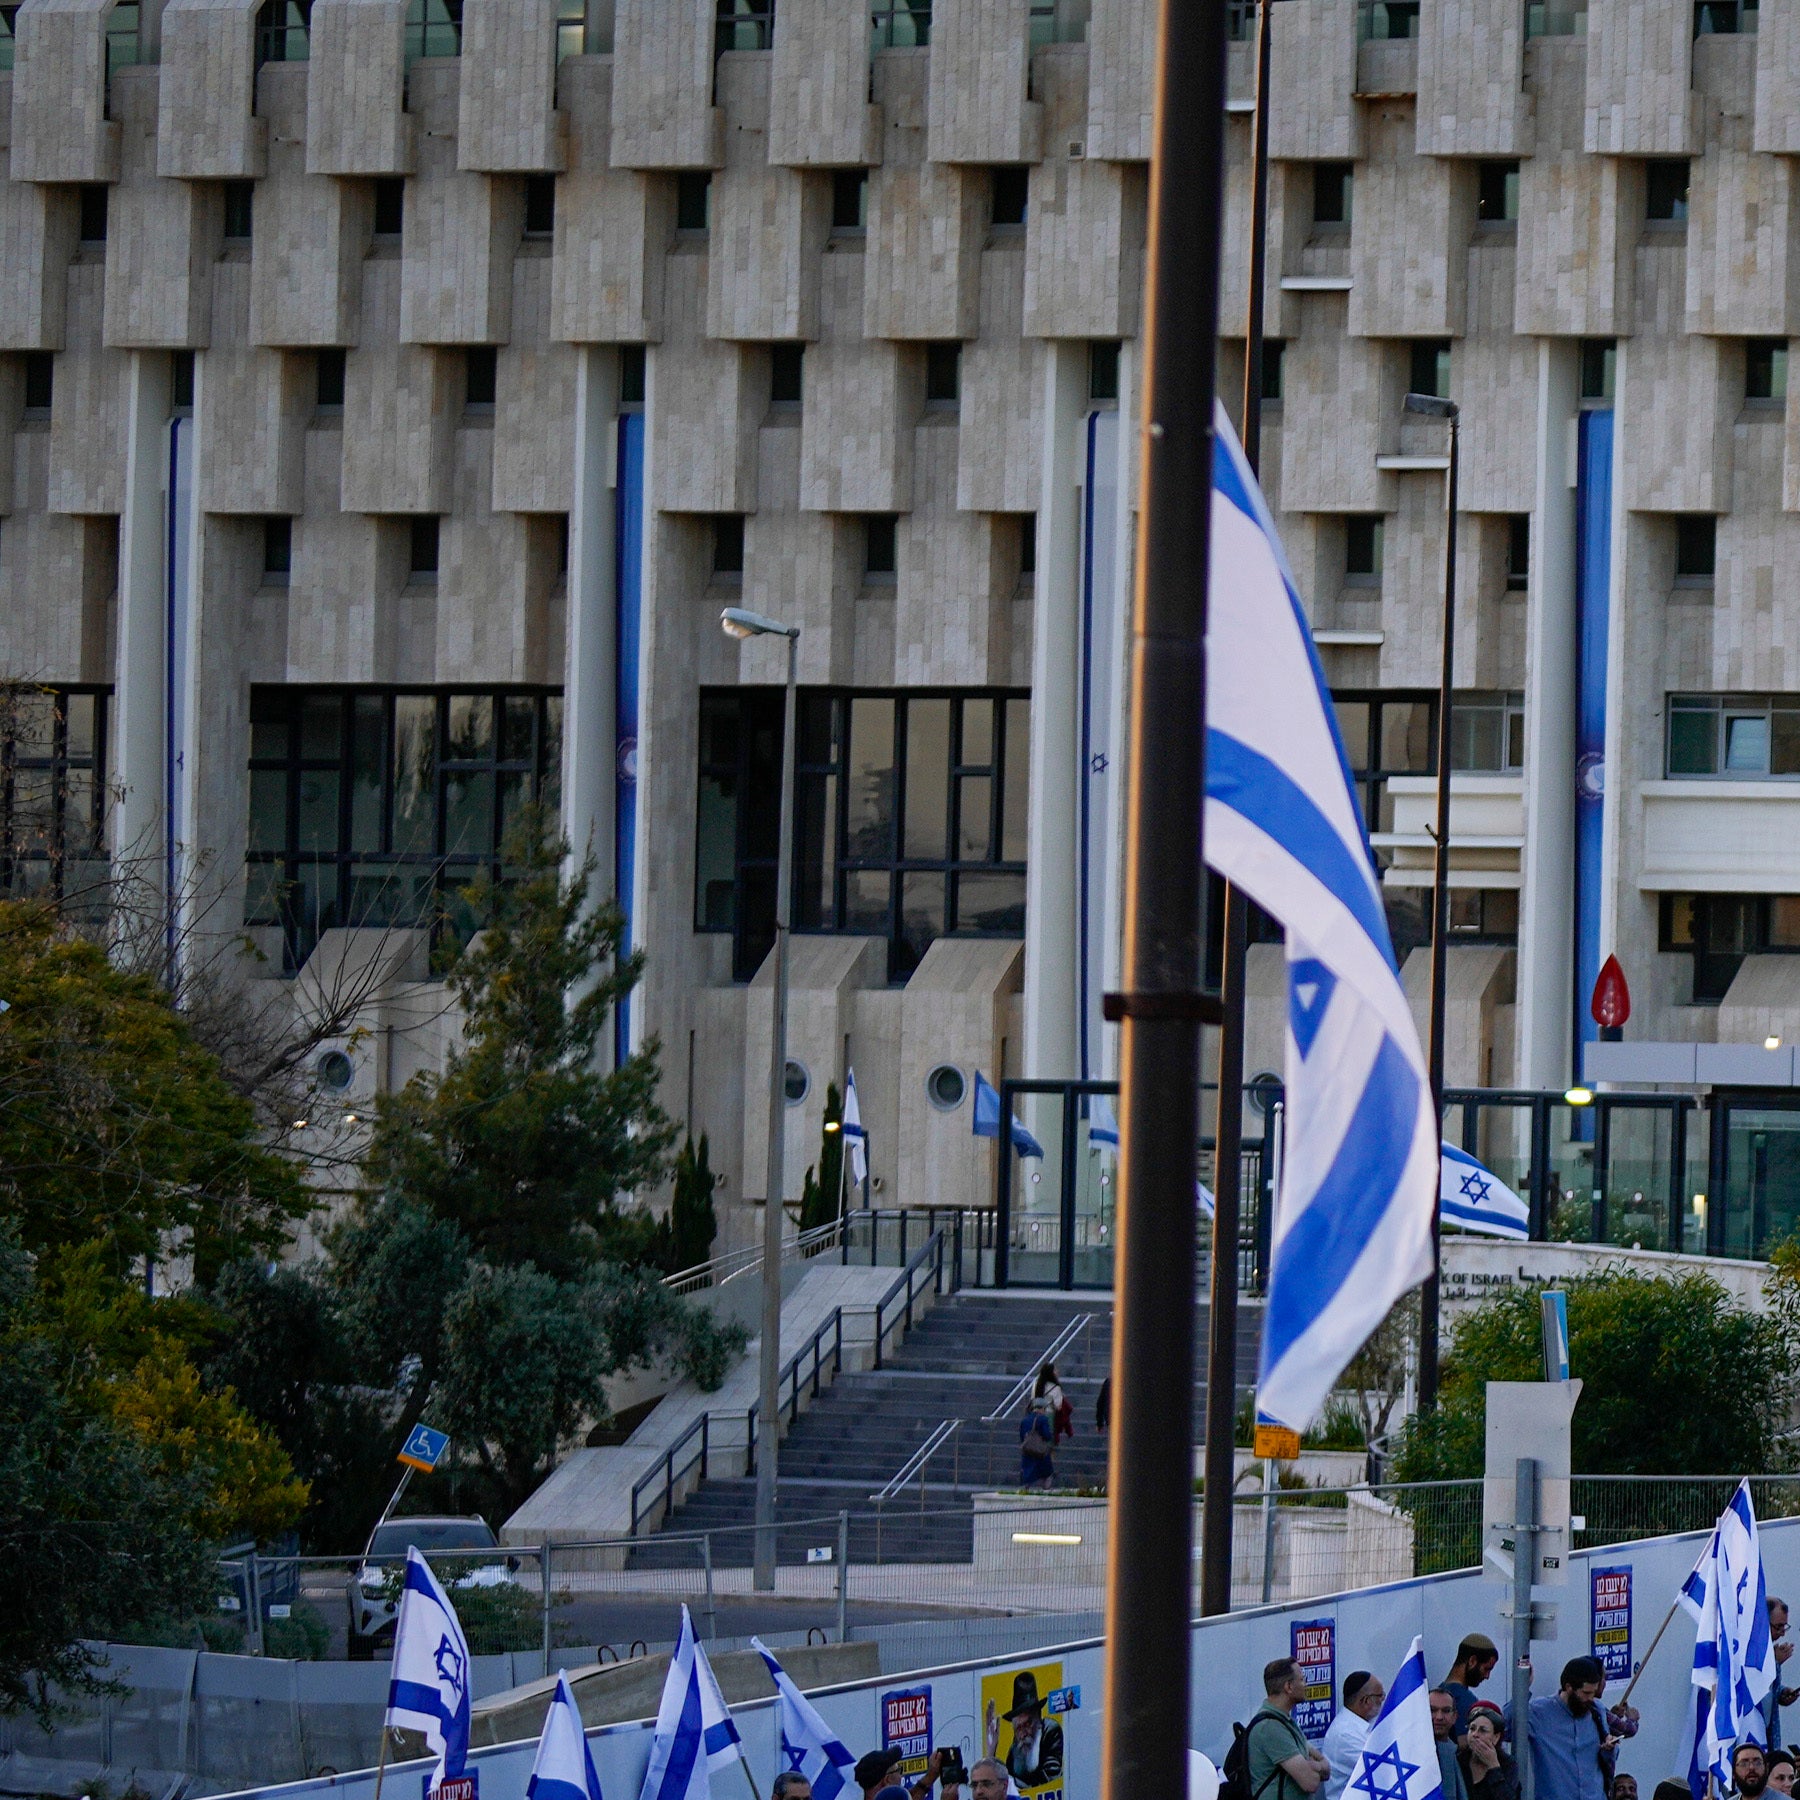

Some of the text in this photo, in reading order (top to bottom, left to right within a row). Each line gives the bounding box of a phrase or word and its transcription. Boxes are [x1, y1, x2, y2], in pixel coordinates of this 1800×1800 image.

[1321, 1628, 1330, 1645] לא
[888, 1702, 898, 1720] לנו
[916, 1696, 926, 1716] לא
[462, 1780, 472, 1800] לא
